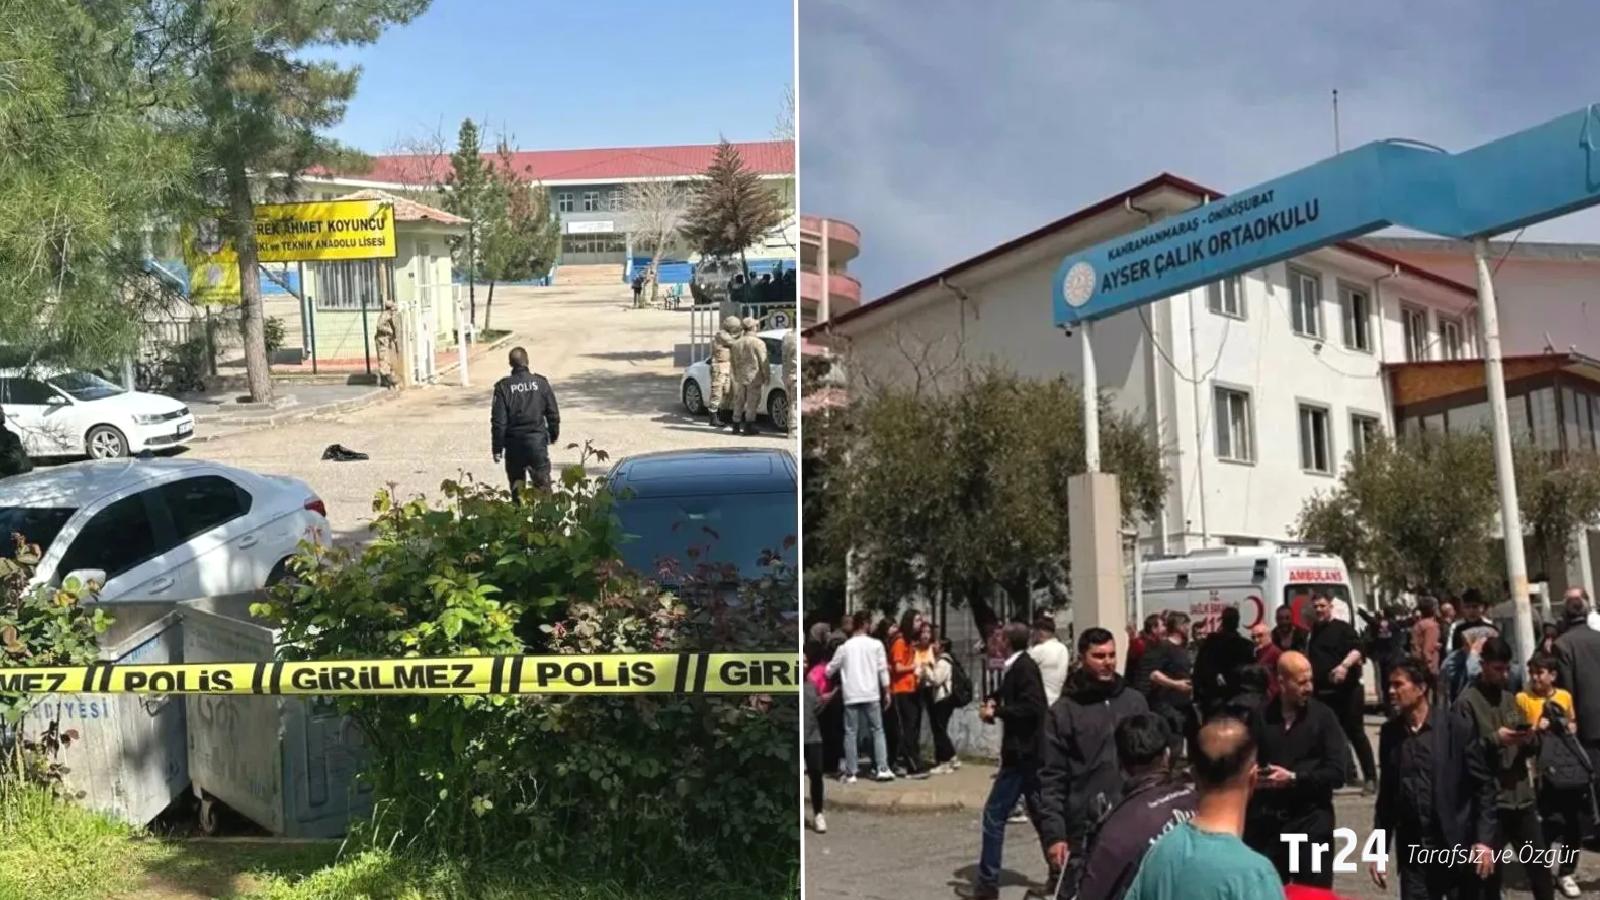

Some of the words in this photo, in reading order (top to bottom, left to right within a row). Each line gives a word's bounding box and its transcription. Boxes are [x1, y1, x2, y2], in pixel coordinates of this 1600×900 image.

[327, 218, 385, 233] KOYUNCU
[281, 239, 313, 252] TEKNİK
[315, 238, 357, 250] ANADOLU
[359, 236, 386, 248] LİSESİ
[1101, 260, 1151, 294] AYSER
[1154, 238, 1204, 280] ÇALIK
[1208, 197, 1320, 256] ORTAOKULU
[1107, 218, 1200, 261] KAHRAMANMARAŞ
[1289, 570, 1343, 583] AMBULANS
